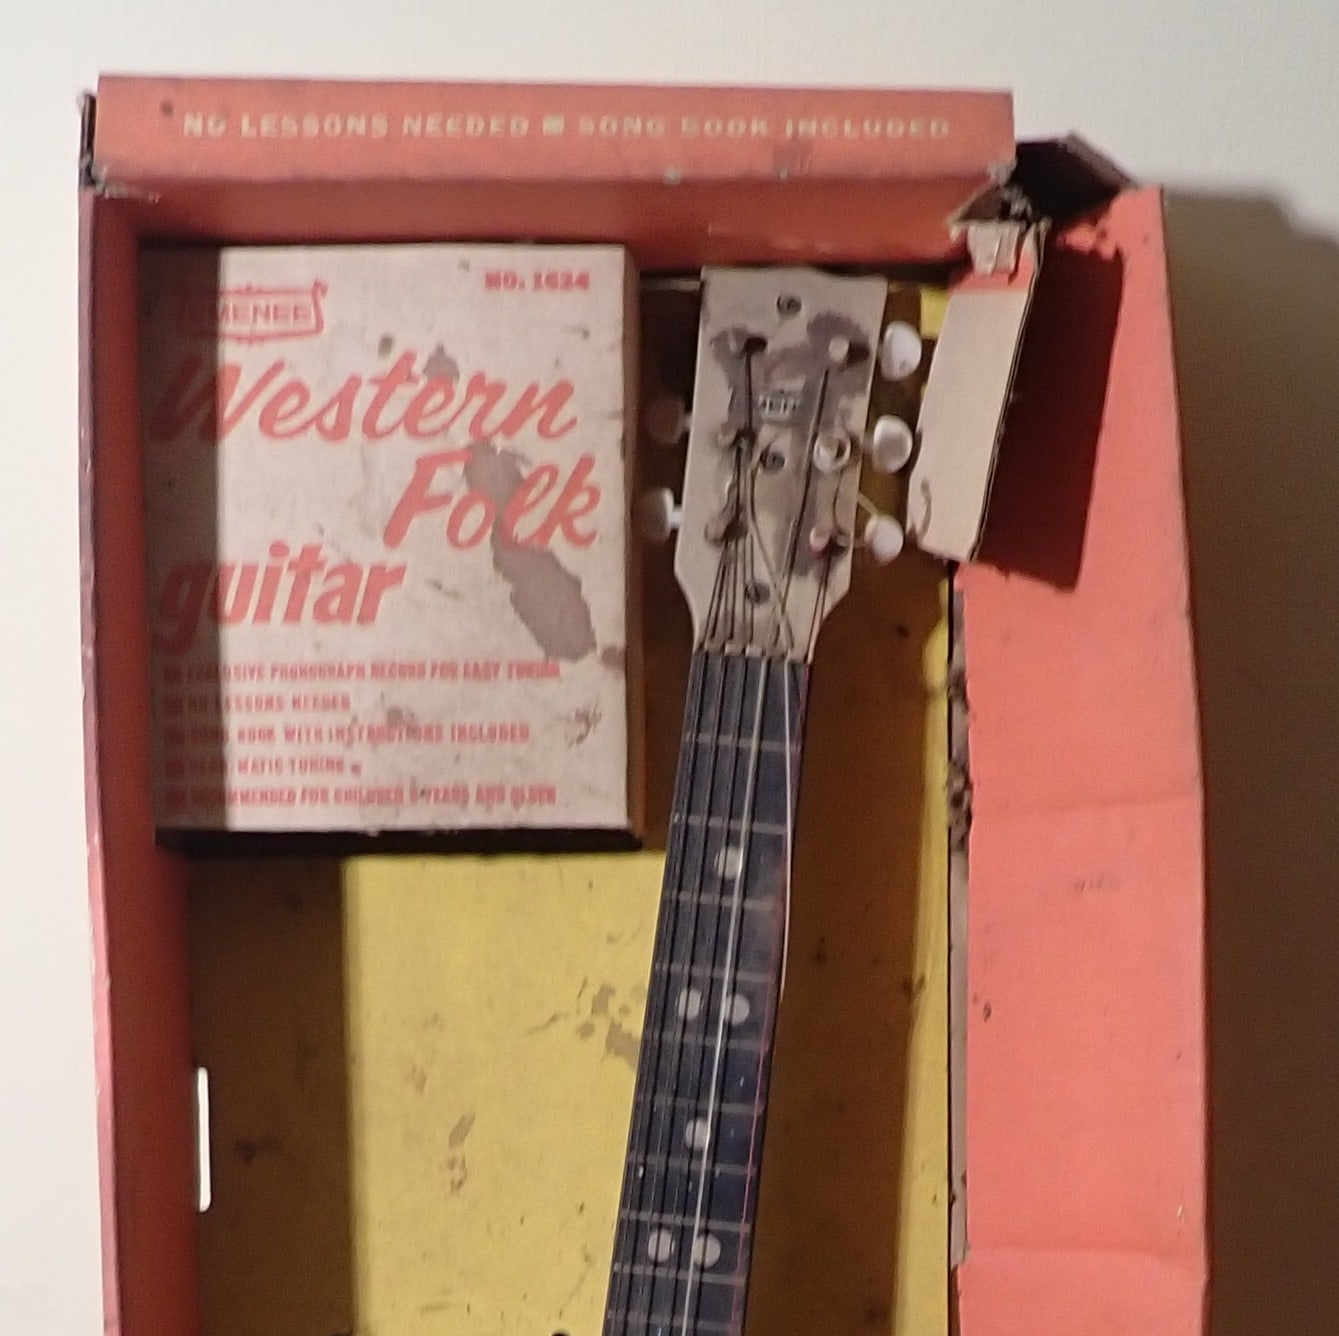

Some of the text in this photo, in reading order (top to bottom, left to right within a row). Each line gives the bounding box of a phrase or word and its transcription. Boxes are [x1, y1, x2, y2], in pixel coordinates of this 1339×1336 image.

[184, 111, 227, 137] NO
[240, 112, 389, 138] LESSONS
[402, 112, 530, 138] NEEDED
[577, 114, 666, 138] SONG
[785, 114, 951, 139] INCLUDED
[150, 349, 578, 443] Western
[383, 449, 602, 551] Folk
[153, 539, 407, 650] guitar
